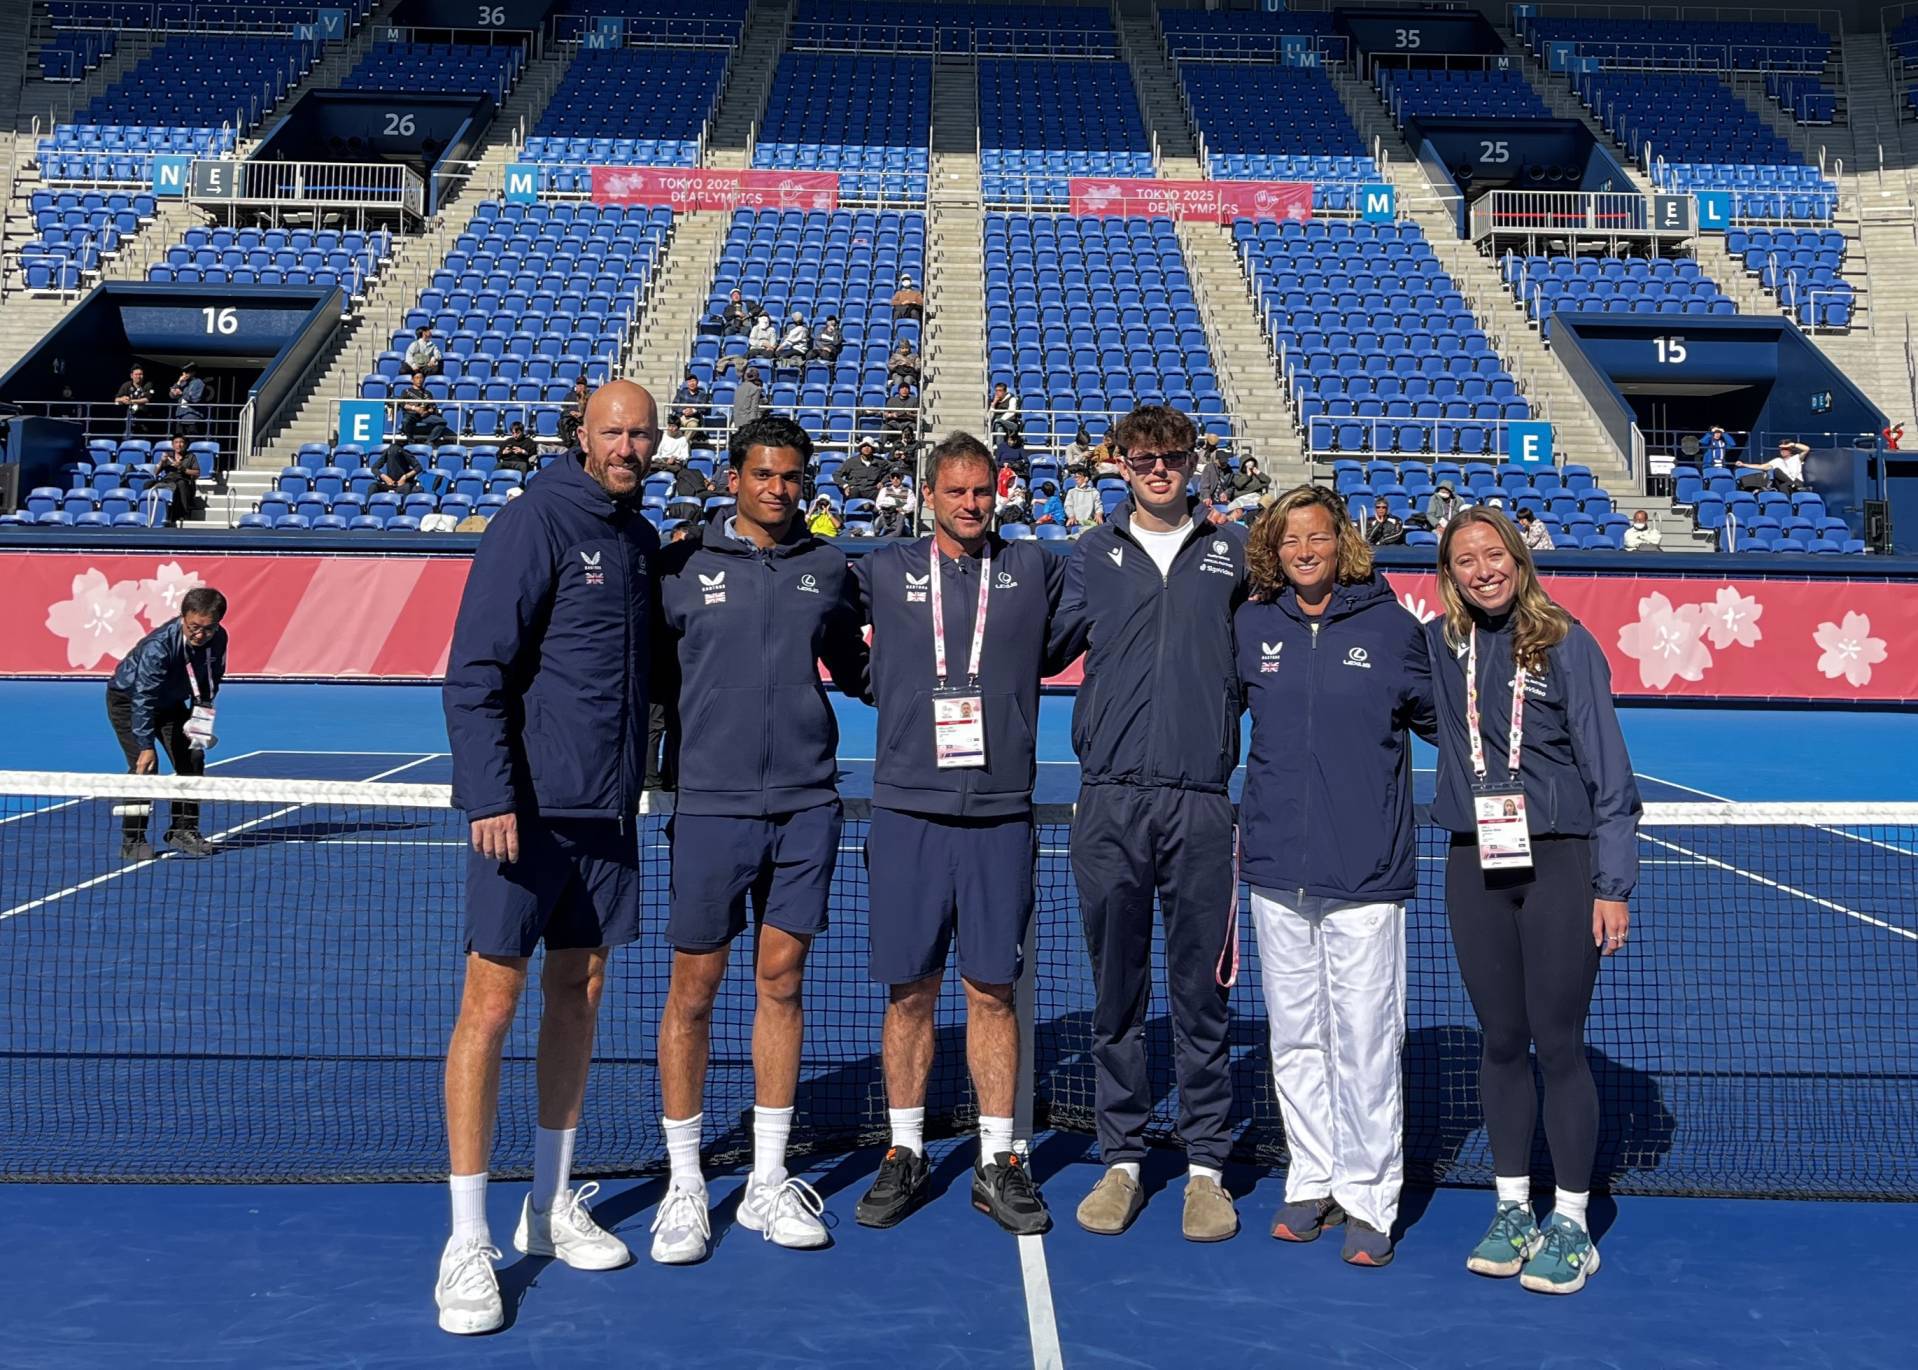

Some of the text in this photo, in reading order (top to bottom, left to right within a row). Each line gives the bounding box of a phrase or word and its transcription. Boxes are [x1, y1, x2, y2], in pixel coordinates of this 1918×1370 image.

[323, 16, 338, 32] V
[477, 6, 506, 26] 36
[300, 25, 313, 40] N
[387, 28, 399, 38] M
[1395, 28, 1421, 48] 35
[589, 34, 605, 49] M
[1300, 53, 1315, 67] M
[1498, 57, 1509, 67] M
[1556, 49, 1568, 65] T
[1582, 58, 1591, 72] L
[383, 113, 416, 136] 26
[1479, 141, 1509, 163] 25
[160, 164, 179, 185] N
[210, 168, 221, 185] E
[509, 174, 533, 194] M
[658, 177, 738, 190] TOKYO 2025
[1135, 188, 1214, 201] TOKYO 2025
[1148, 202, 1239, 215] DEAFLYMPCS
[1367, 193, 1390, 214] M
[1667, 201, 1678, 218] E
[1708, 200, 1721, 220] L
[202, 306, 238, 335] 16
[1653, 336, 1687, 363] 15
[353, 413, 371, 441] E
[1523, 435, 1540, 461] E
